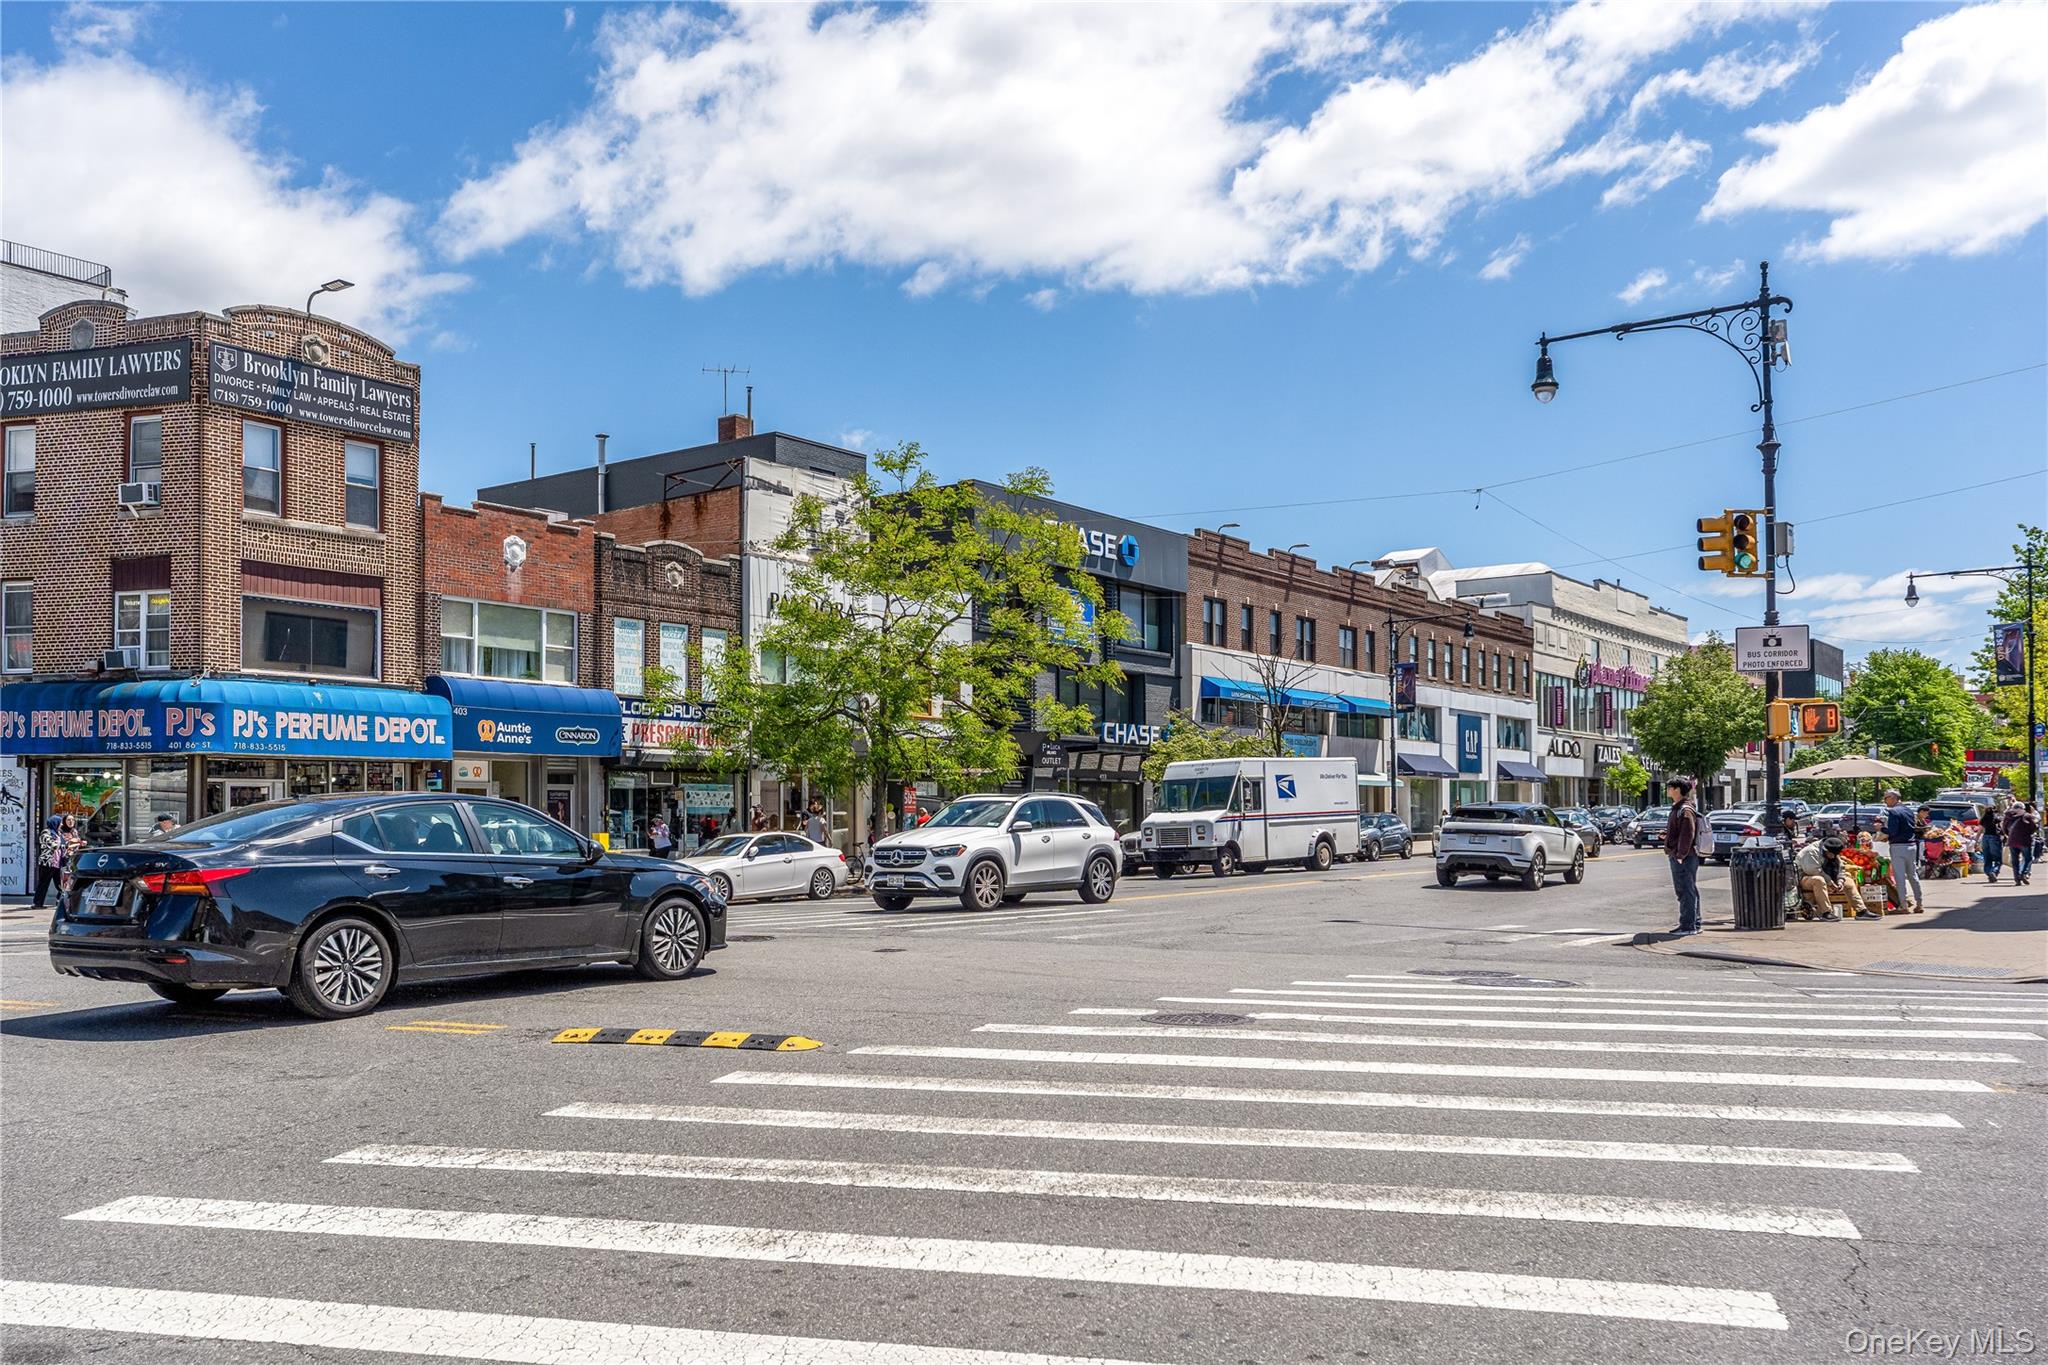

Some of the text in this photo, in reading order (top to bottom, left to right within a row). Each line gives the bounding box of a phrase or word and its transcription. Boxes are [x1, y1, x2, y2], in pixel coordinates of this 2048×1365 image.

[52, 357, 104, 382] FAMILY
[109, 349, 181, 377] LAWYERS
[244, 352, 411, 409] Brooklyn Family Lawyers
[8, 386, 72, 411] 759-1000
[76, 383, 178, 403] www.towersdivorcelaw.com
[214, 389, 293, 416] (718) 759-1000
[215, 373, 411, 424] DIVORCE FAMILY LAW APPEALS REAL ESTATE
[299, 408, 411, 439] www.towersdivorcelaw.com
[1763, 650, 1799, 658] CORRIDOR
[454, 706, 468, 716] 403
[1827, 708, 1836, 729] 8
[0, 711, 26, 739] PJ's
[31, 710, 93, 738] PERFUME
[165, 707, 216, 740] PJ's
[233, 709, 268, 739] PJ's
[275, 711, 368, 742] PERFUME
[497, 721, 532, 734] Auntie
[1102, 722, 1161, 746] CHASE
[106, 742, 152, 750] 718-833-5515
[169, 742, 182, 750] 401
[233, 742, 286, 751] 718-833-5515
[497, 733, 533, 745] Anne's
[558, 731, 597, 741] CINNABON
[1466, 730, 1479, 753] GAP
[1547, 738, 1581, 760] ALDO
[1598, 745, 1622, 764] ZALES
[1042, 757, 1062, 766] OUTLET
